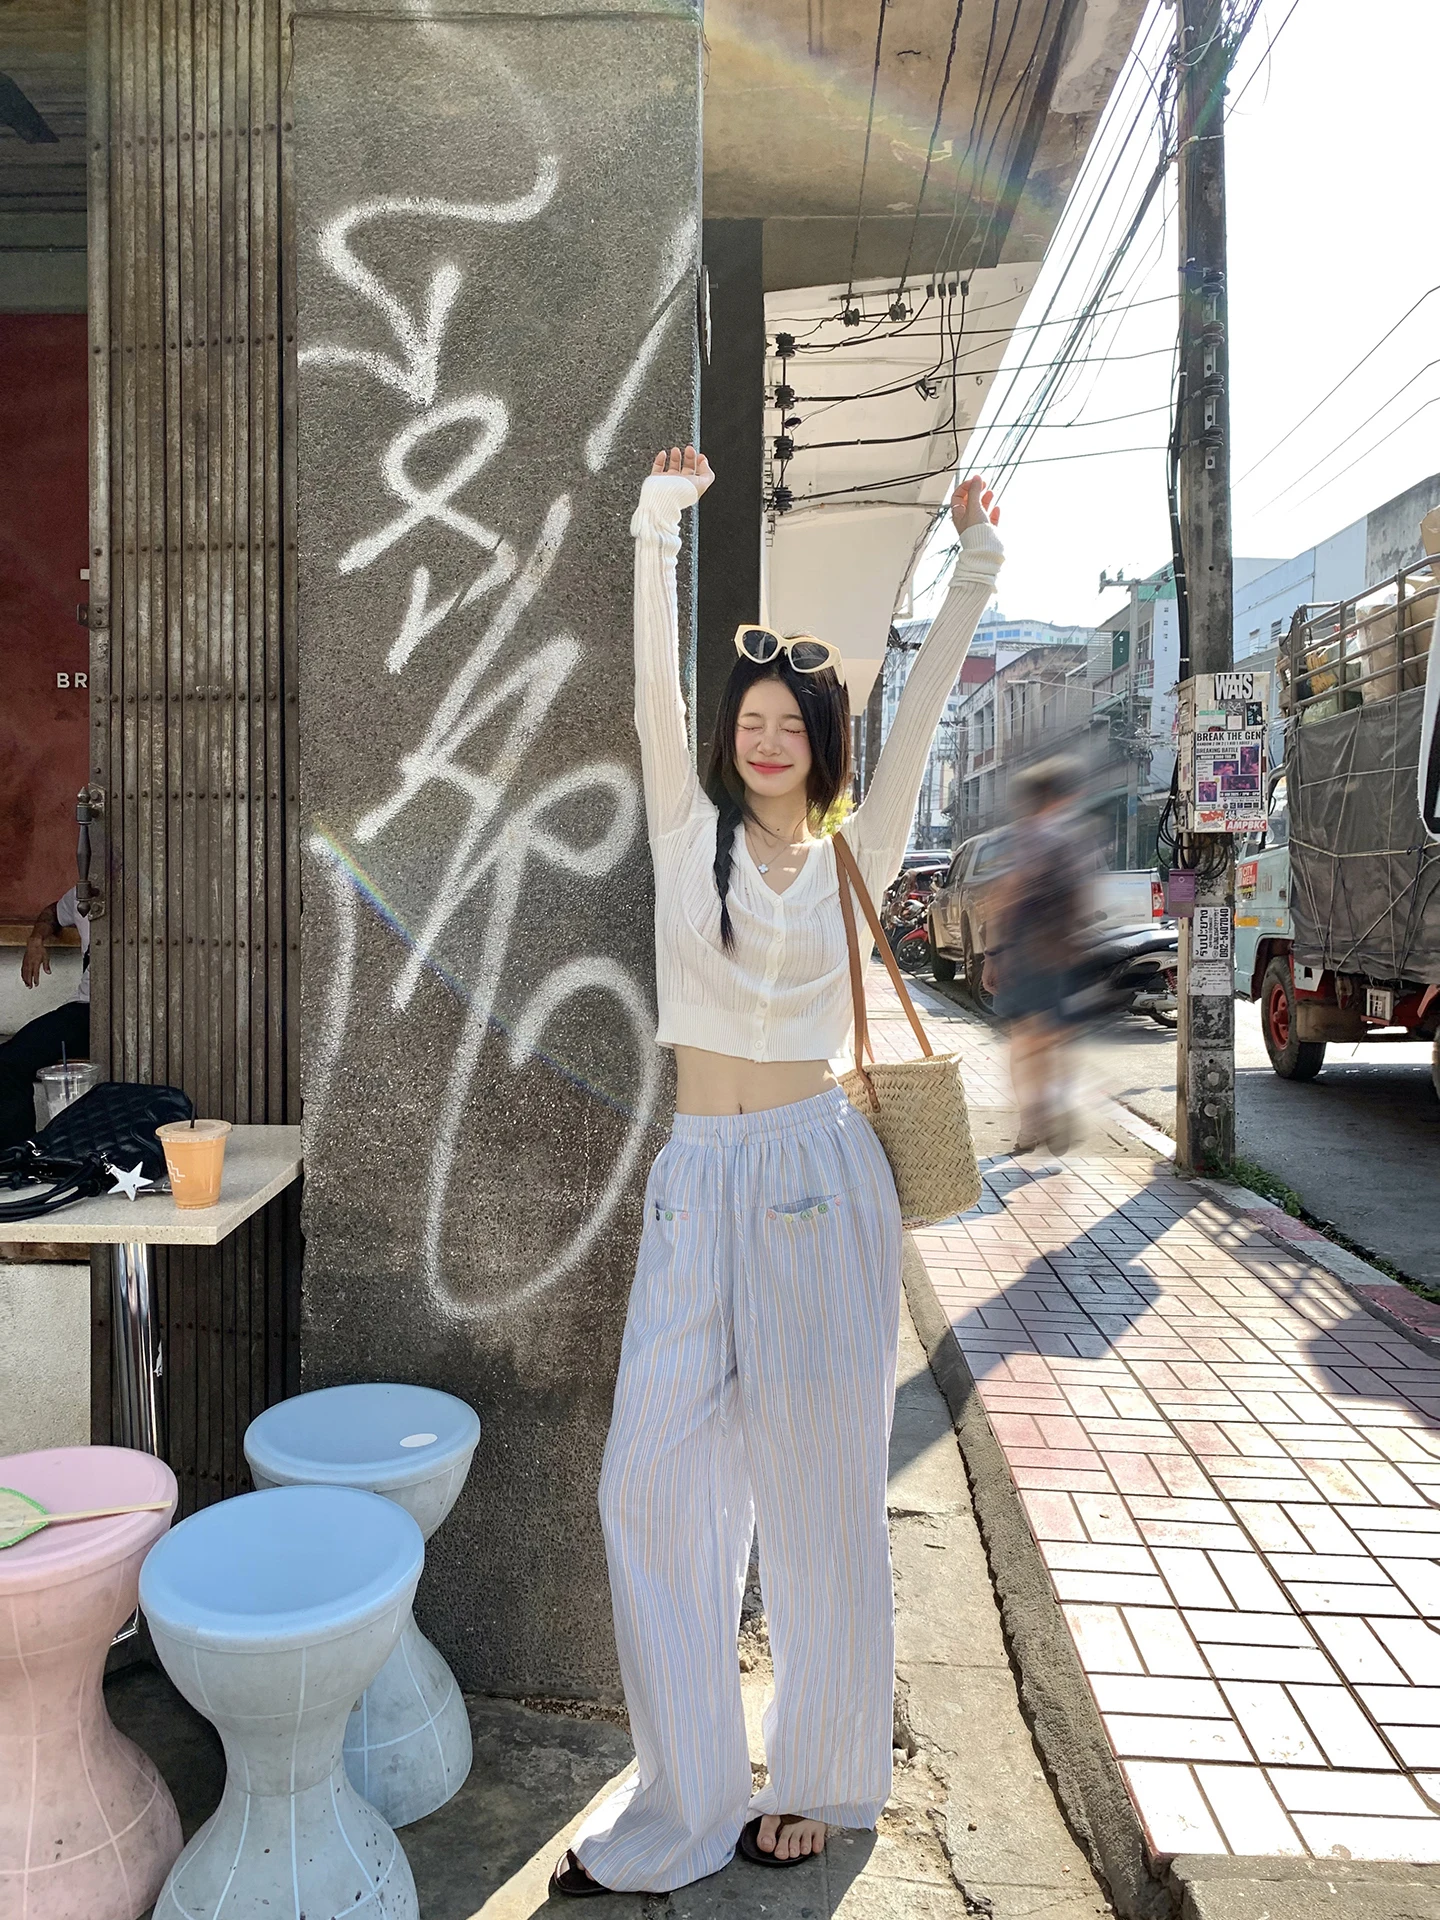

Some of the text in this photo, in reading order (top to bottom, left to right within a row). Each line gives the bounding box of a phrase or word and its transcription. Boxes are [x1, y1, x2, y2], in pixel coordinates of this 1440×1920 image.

[1196, 731, 1261, 741] BREAK THE GEN
[1219, 908, 1229, 958] 092-5407040
